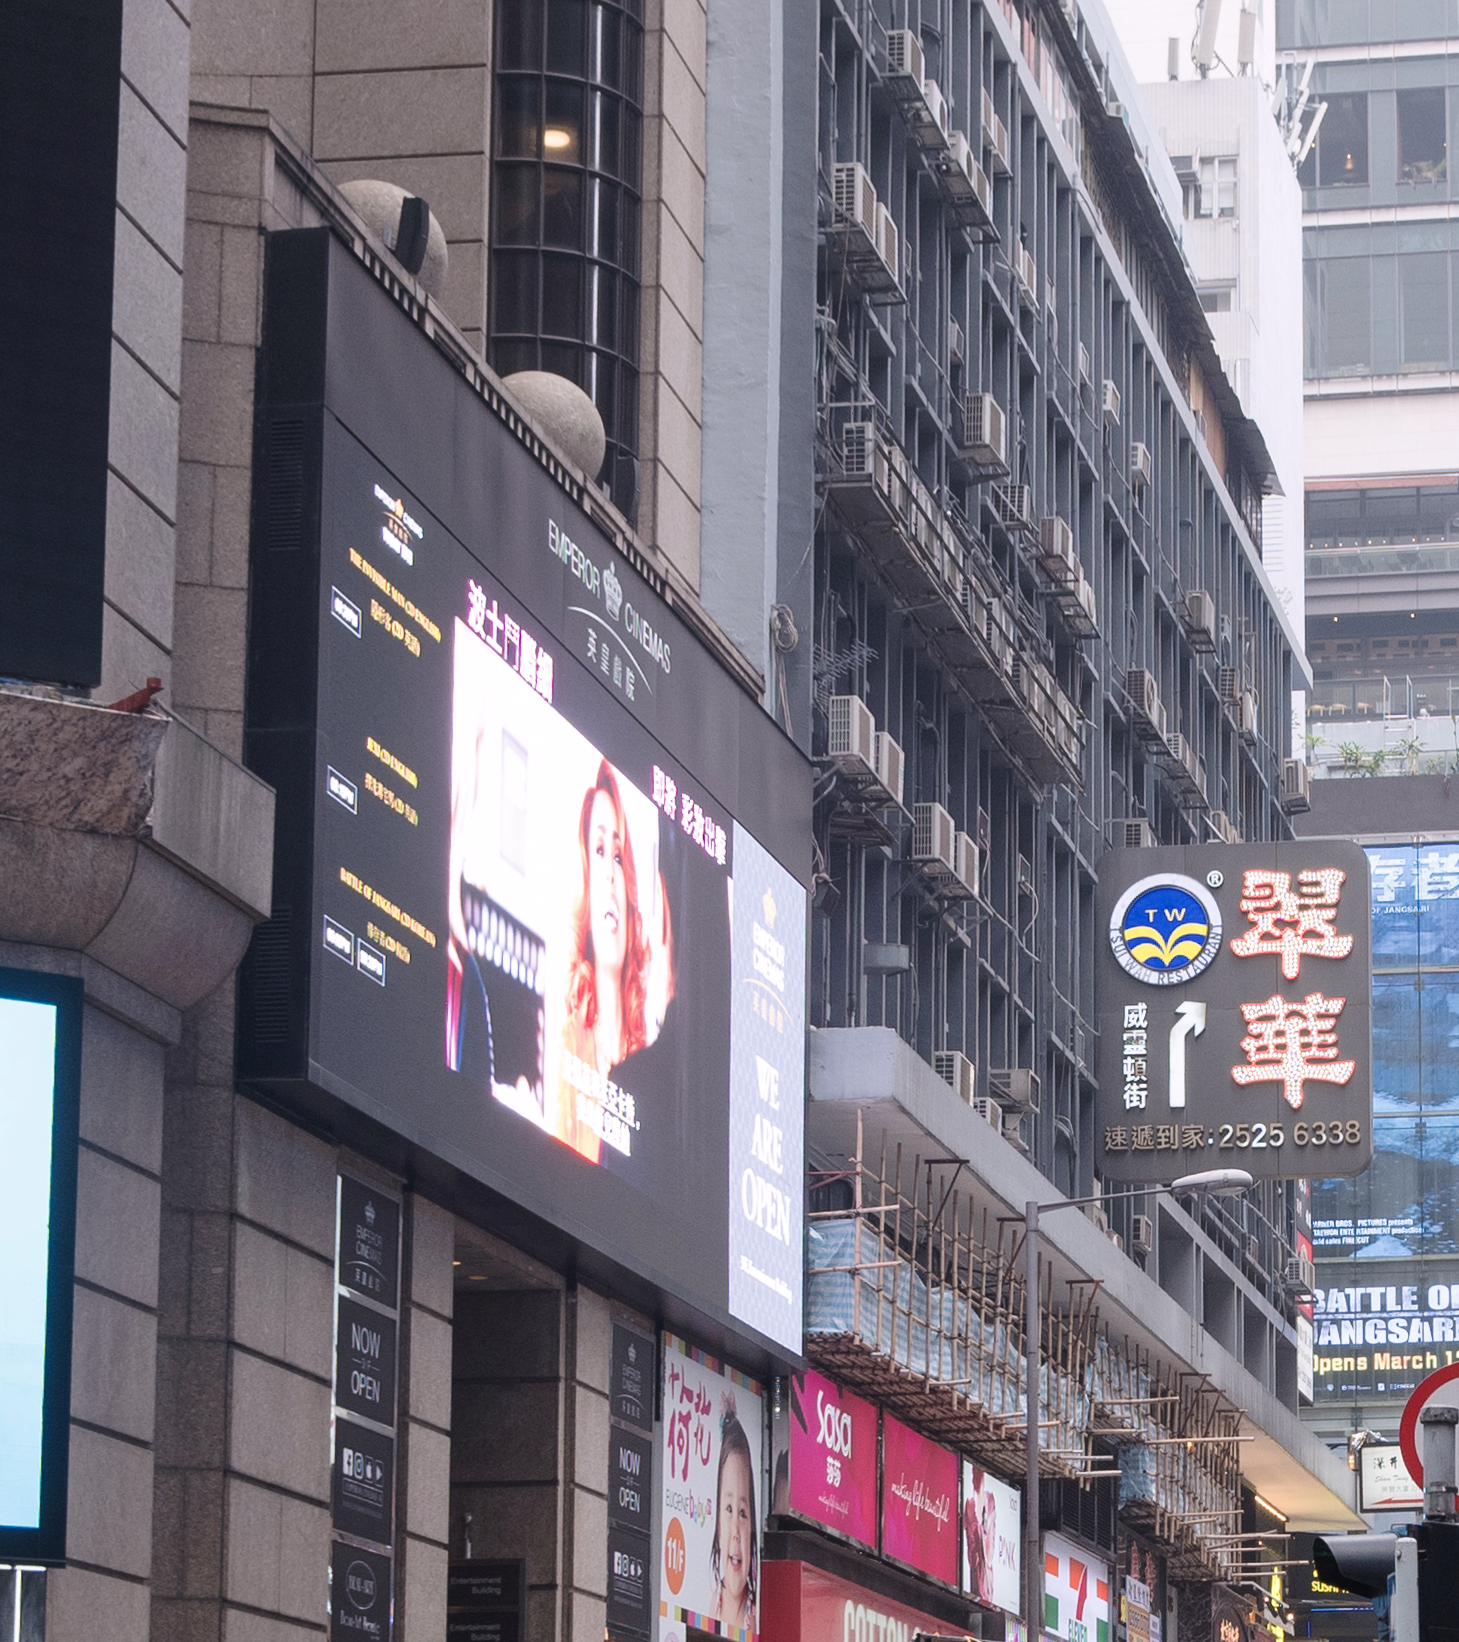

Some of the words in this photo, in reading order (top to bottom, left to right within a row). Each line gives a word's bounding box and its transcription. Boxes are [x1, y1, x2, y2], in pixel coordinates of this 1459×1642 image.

[548, 518, 601, 598] EMPEROR
[624, 602, 672, 674] CINEMAS
[1229, 867, 1356, 1110] 翠華
[1122, 1001, 1149, 1110] 威靈頓街
[754, 1055, 780, 1111] WE
[750, 1113, 784, 1176] ARE
[1218, 1122, 1286, 1149] 2525
[1292, 1120, 1362, 1146] 6338
[740, 1167, 791, 1247] OPEN
[1357, 1218, 1388, 1227] PICTURES
[1313, 1285, 1419, 1313] BATTLE
[351, 1322, 381, 1359] NOW
[1373, 1350, 1438, 1371] March
[350, 1370, 380, 1403] OPEN
[667, 1361, 712, 1483] 荷花
[618, 1447, 641, 1477] NOW
[618, 1486, 641, 1514] OPEN
[667, 1535, 685, 1575] 11/F
[471, 1586, 502, 1596] Building
[470, 1632, 501, 1642] Building
